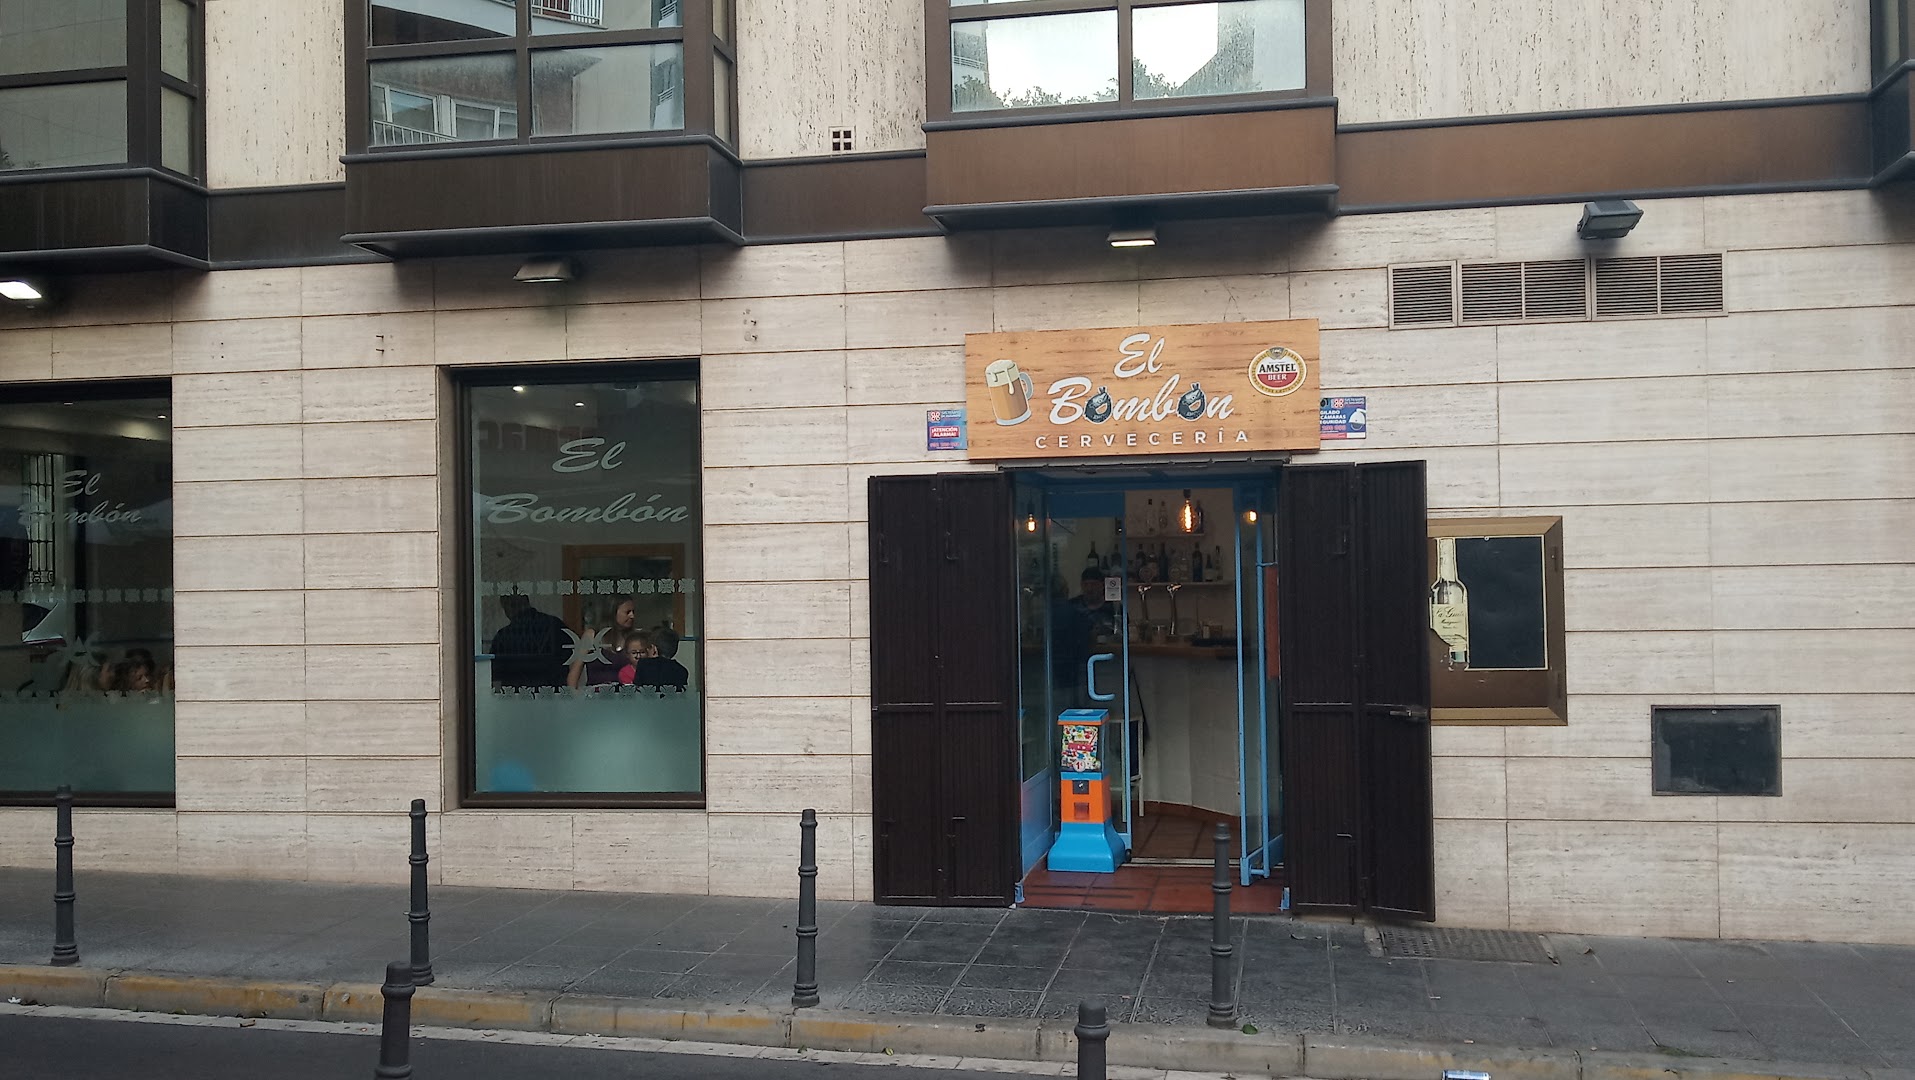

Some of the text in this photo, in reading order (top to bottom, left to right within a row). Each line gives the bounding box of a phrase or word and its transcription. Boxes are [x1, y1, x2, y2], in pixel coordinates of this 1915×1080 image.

[1113, 333, 1165, 378] El
[1259, 363, 1297, 373] AMSTEL
[1035, 428, 1249, 449] CERVECERÍA
[552, 437, 626, 473] El
[61, 470, 101, 498] El
[486, 492, 689, 524] Bombón
